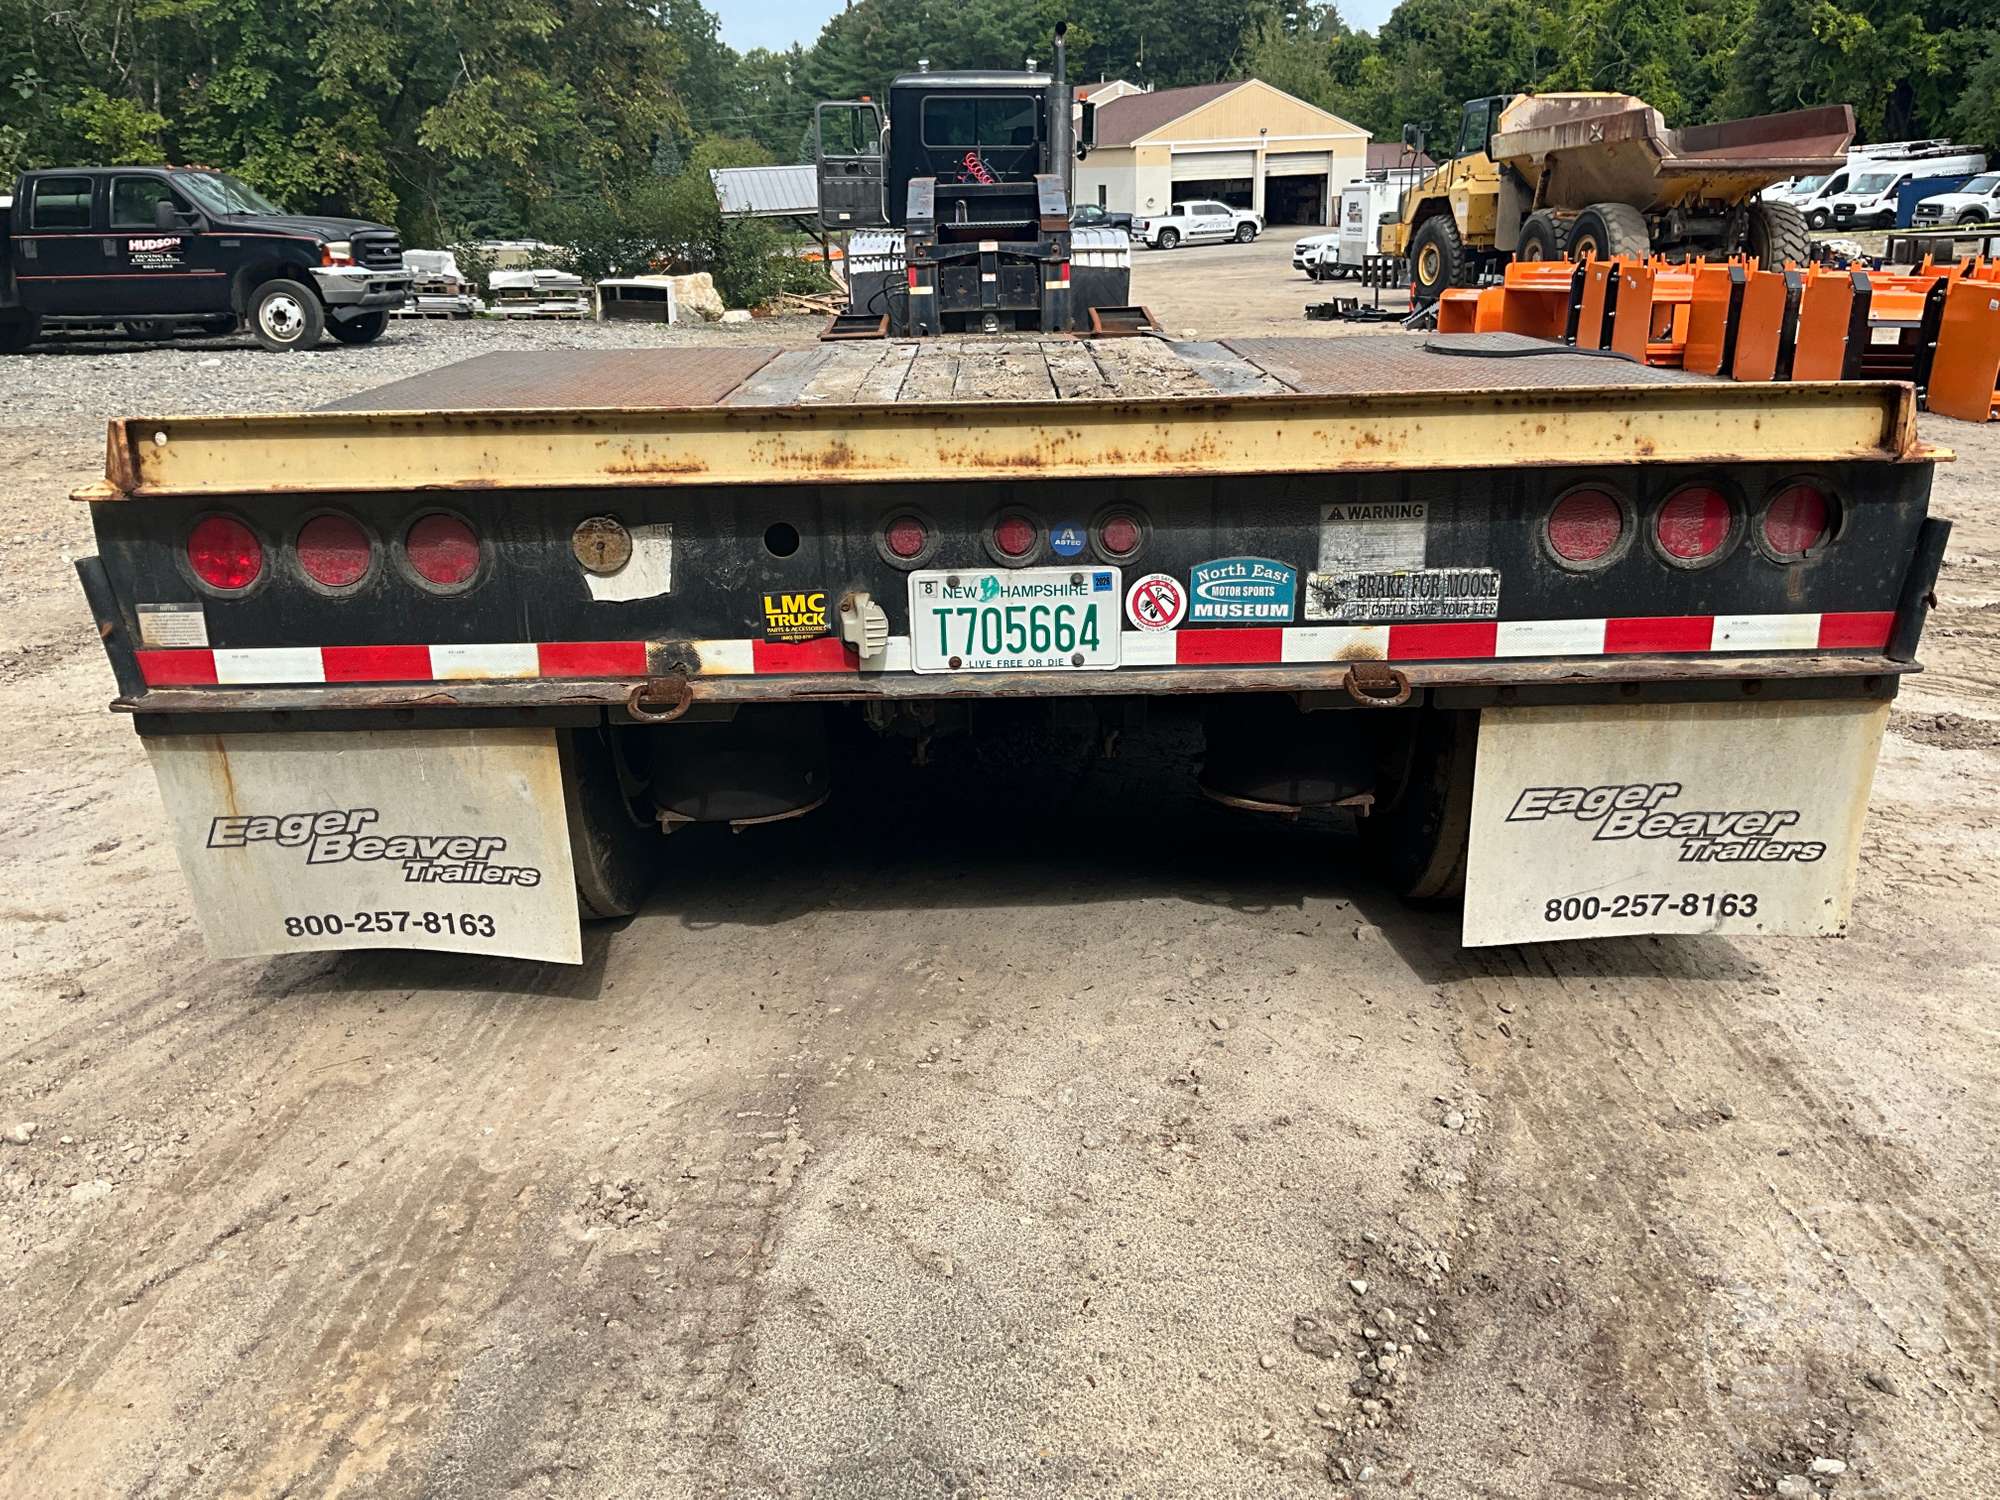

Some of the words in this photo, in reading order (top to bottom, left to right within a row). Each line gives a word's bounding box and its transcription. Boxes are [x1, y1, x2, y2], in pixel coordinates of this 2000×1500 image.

[128, 237, 181, 251] HUDSON
[1348, 504, 1424, 519] WARNING
[1197, 563, 1246, 583] North
[1251, 564, 1290, 583] East
[924, 583, 933, 594] 8
[942, 586, 977, 599] NEW
[1000, 584, 1088, 598] HAMPSHIRE
[1211, 586, 1240, 597] MOTOR
[1242, 586, 1275, 597] SPORTS
[1357, 574, 1406, 598] BRAKE
[1411, 573, 1440, 597] FOR
[1445, 573, 1499, 597] MOOSE
[764, 593, 826, 614] LMC
[1194, 604, 1289, 619] MUSEUM
[1356, 604, 1368, 616] IT
[1410, 602, 1437, 615] SAVE
[1441, 602, 1469, 615] YOUR
[1474, 602, 1496, 614] LIFE
[766, 613, 825, 627] TRUCK
[932, 603, 1100, 656] T705664
[969, 660, 992, 668] LIVE
[997, 660, 1023, 668] FREE
[1028, 659, 1042, 667] OR
[1049, 658, 1064, 666] DIE
[1505, 782, 1682, 822] Eager
[206, 808, 379, 849] Eager
[1592, 809, 1800, 841] Beaver
[306, 833, 506, 864] Beaver
[1679, 838, 1827, 862] Trailers
[402, 860, 541, 887] Trailers
[1544, 893, 1758, 922] 800-257-8163
[284, 911, 496, 938] 800-257-8163
